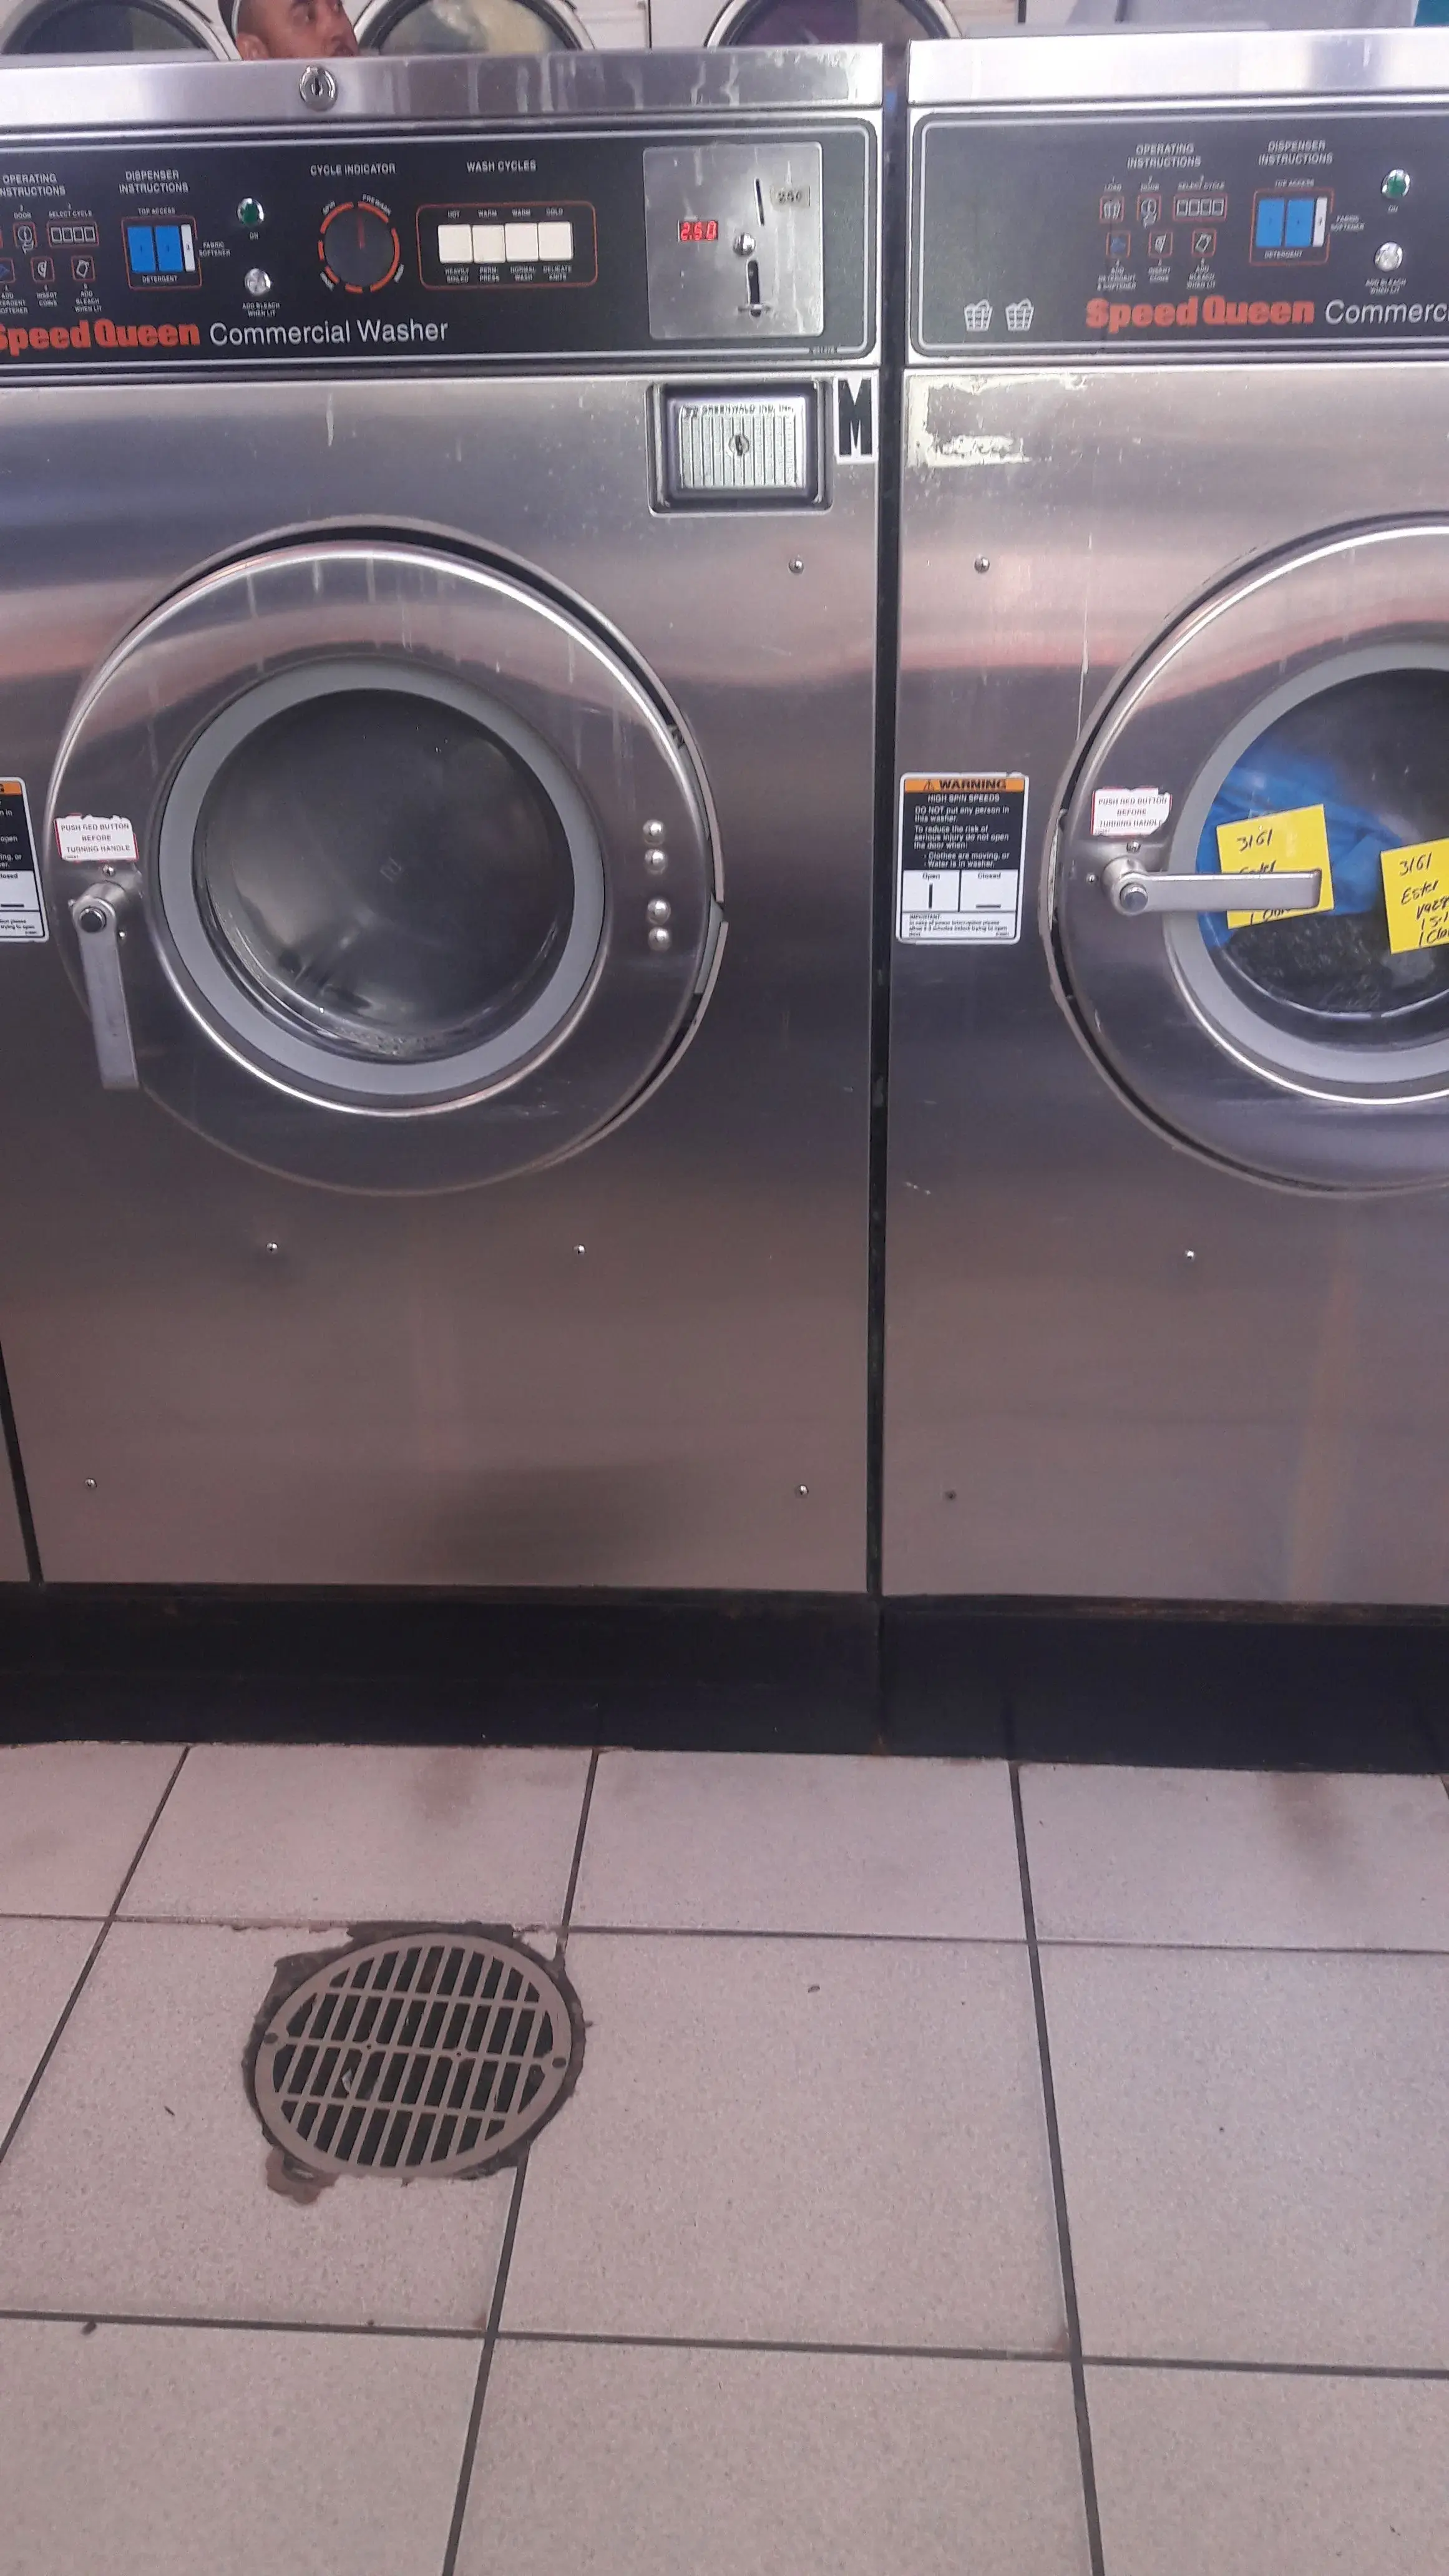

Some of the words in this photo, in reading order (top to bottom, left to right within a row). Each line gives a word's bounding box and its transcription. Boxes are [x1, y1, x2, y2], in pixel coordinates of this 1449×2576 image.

[1136, 143, 1194, 155] OPERATING
[1268, 140, 1326, 152] DISPENSER
[1127, 156, 1201, 168] INSTRUCTIONS
[1259, 153, 1334, 165] INSTRUCTIONS
[310, 164, 342, 177] CYCLE
[344, 163, 396, 176] INDICATOR
[467, 160, 495, 172] WASH
[497, 159, 537, 172] CYCLES
[2, 173, 57, 185] OPERATING
[125, 169, 179, 181] DISPENSER
[0, 185, 66, 197] NSTRUCTIONS
[119, 182, 189, 194] INSTRUCTIONS
[138, 207, 150, 215] TOP
[152, 207, 176, 215] ACCESS
[478, 209, 497, 218] WARM
[512, 208, 531, 217] WARM
[545, 207, 564, 216] COLD
[680, 220, 717, 241] 2.50
[250, 232, 258, 240] ON
[199, 249, 231, 257] SOFTENER
[142, 275, 178, 283] DETERGENT
[1086, 296, 1199, 334] Speed
[1203, 295, 1315, 326] Queen
[94, 318, 200, 348] Queen
[210, 320, 351, 346] Commercial
[356, 318, 449, 343] Washer
[939, 779, 1007, 790] WARNING
[928, 794, 947, 803] HIGH
[949, 794, 967, 803] SPIN
[968, 793, 1000, 803] SPEEDS
[1098, 798, 1118, 806] PUSH
[1137, 796, 1167, 804] BUTTON
[915, 806, 927, 814] DO
[929, 806, 944, 814] NOT
[946, 806, 958, 816] put
[960, 807, 973, 816] any
[975, 806, 1001, 816] person
[1002, 805, 1010, 814] in
[915, 814, 929, 822] this
[61, 824, 80, 832] PUSH
[100, 822, 129, 831] BUTTON
[915, 825, 924, 833] To
[925, 824, 950, 833] reduce
[952, 824, 964, 833] the
[965, 824, 978, 833] risk
[980, 824, 989, 832] of
[82, 834, 112, 842] BEFORE
[914, 833, 941, 841] serious
[943, 833, 964, 843] injury
[965, 833, 975, 841] do
[977, 833, 989, 841] not
[990, 833, 1009, 842] open
[1236, 829, 1273, 852] 3161
[67, 846, 99, 854] TURNING
[101, 844, 131, 852] HANDLE
[914, 841, 925, 849] the
[927, 841, 944, 849] door
[0, 854, 13, 862] ing,
[928, 851, 957, 860] Clothes
[928, 860, 949, 869] Water
[950, 860, 957, 868] is
[1399, 851, 1432, 876] 3161
[922, 872, 940, 881] Open
